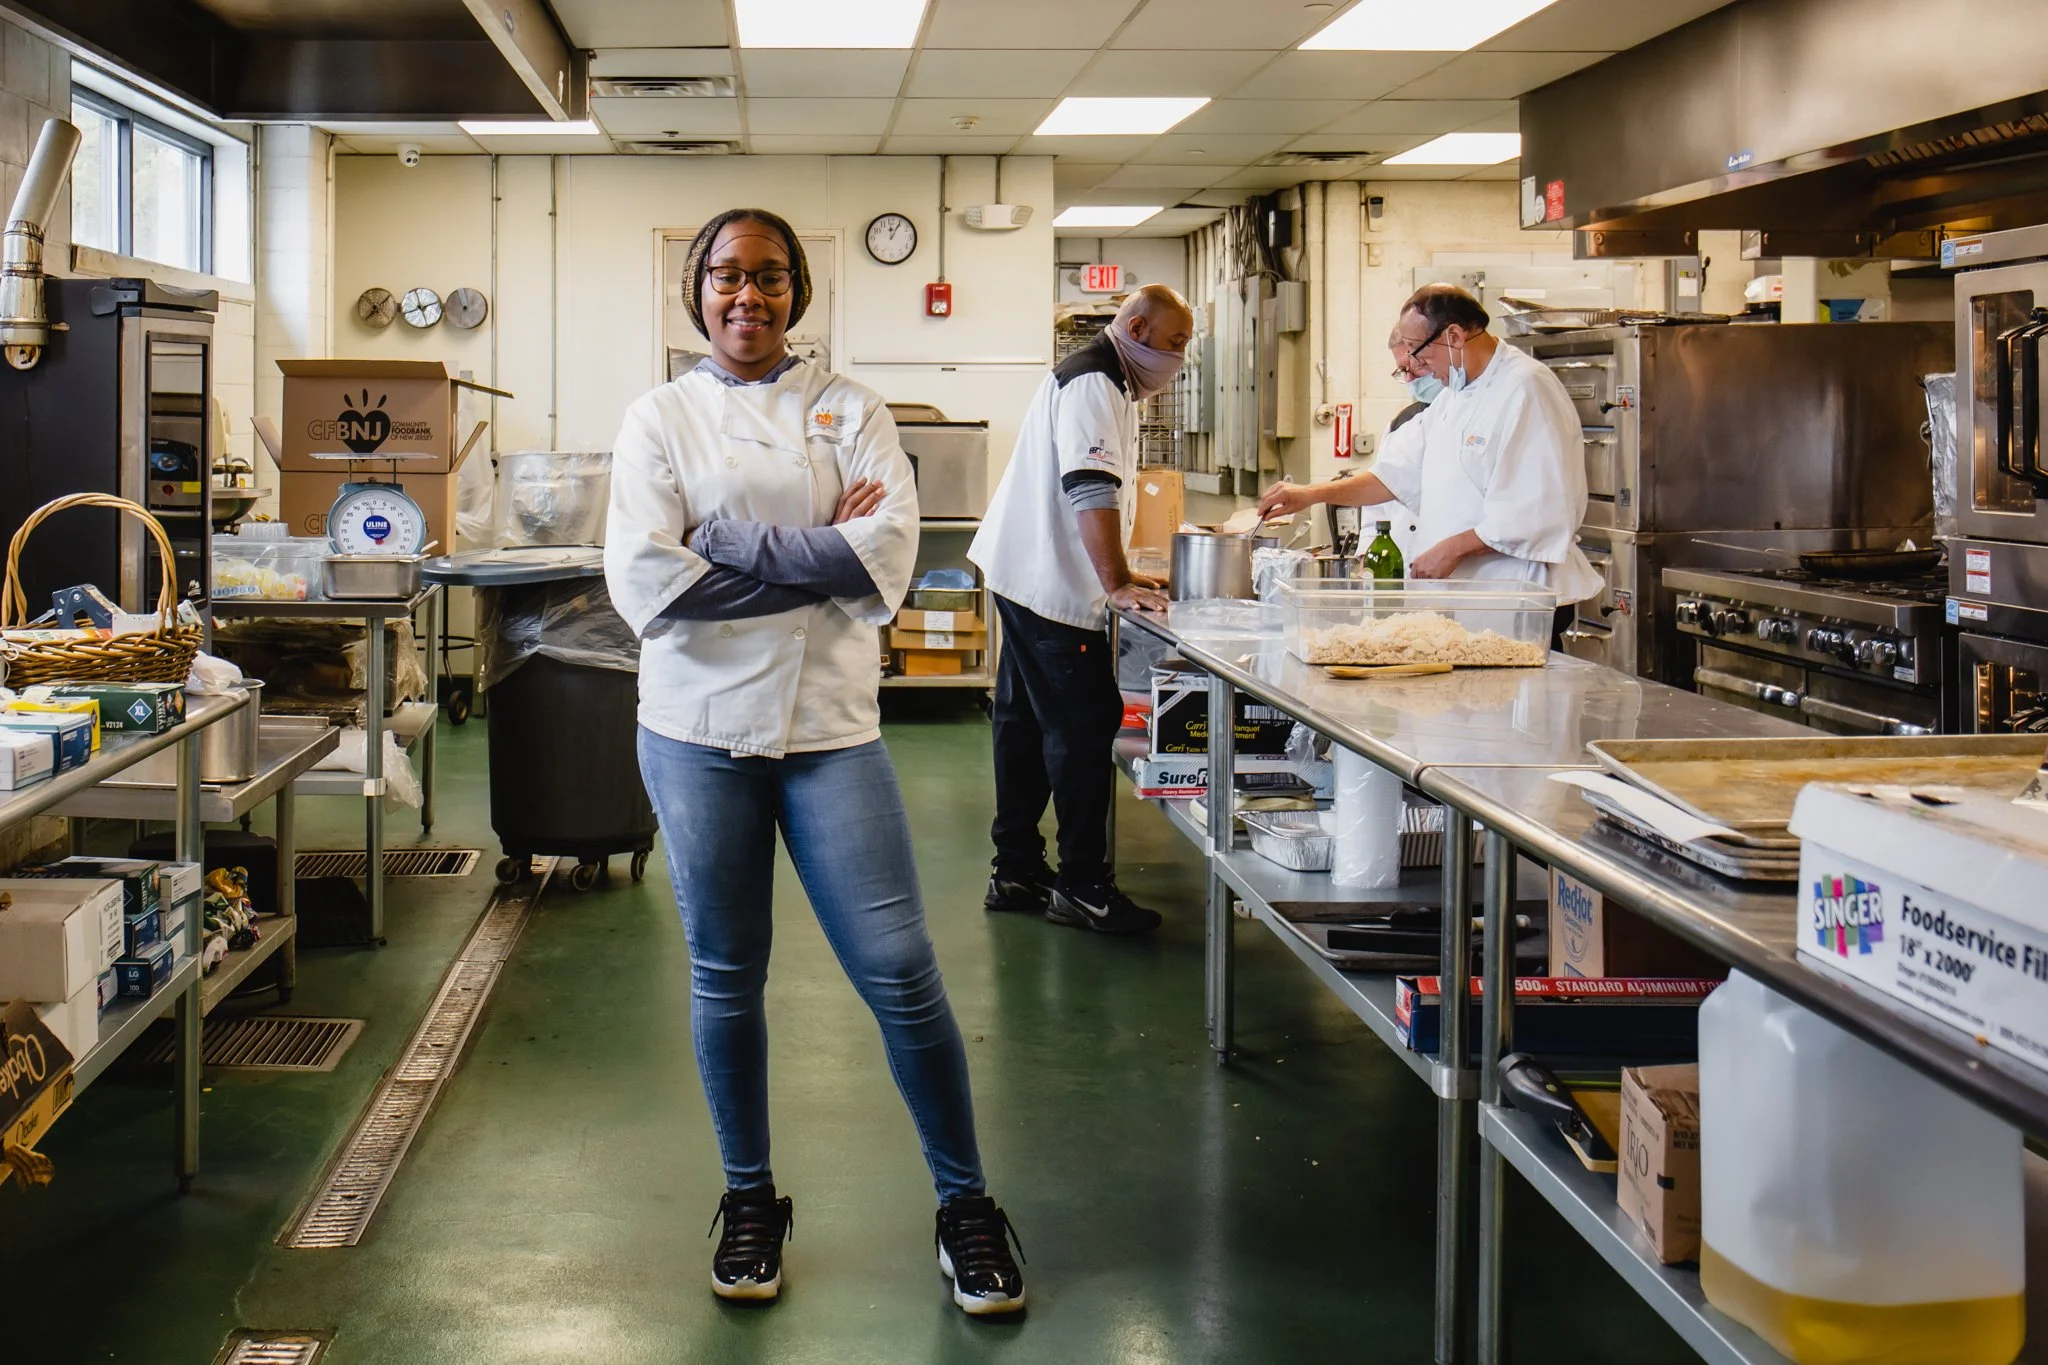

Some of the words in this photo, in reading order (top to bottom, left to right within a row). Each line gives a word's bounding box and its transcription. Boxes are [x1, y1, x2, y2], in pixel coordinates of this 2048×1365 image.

[1089, 266, 1118, 289] EXIT
[308, 420, 382, 441] CFBNJ
[134, 707, 146, 717] XL
[105, 721, 123, 729] V2124
[1558, 875, 1593, 927] RedHot
[1813, 891, 1884, 932] SINGER
[1901, 894, 2017, 970] Foodservice
[1924, 949, 1932, 967] x
[128, 970, 140, 978] LG
[1555, 981, 1624, 993] STANDARD
[1627, 982, 1698, 993] ALUMINUM
